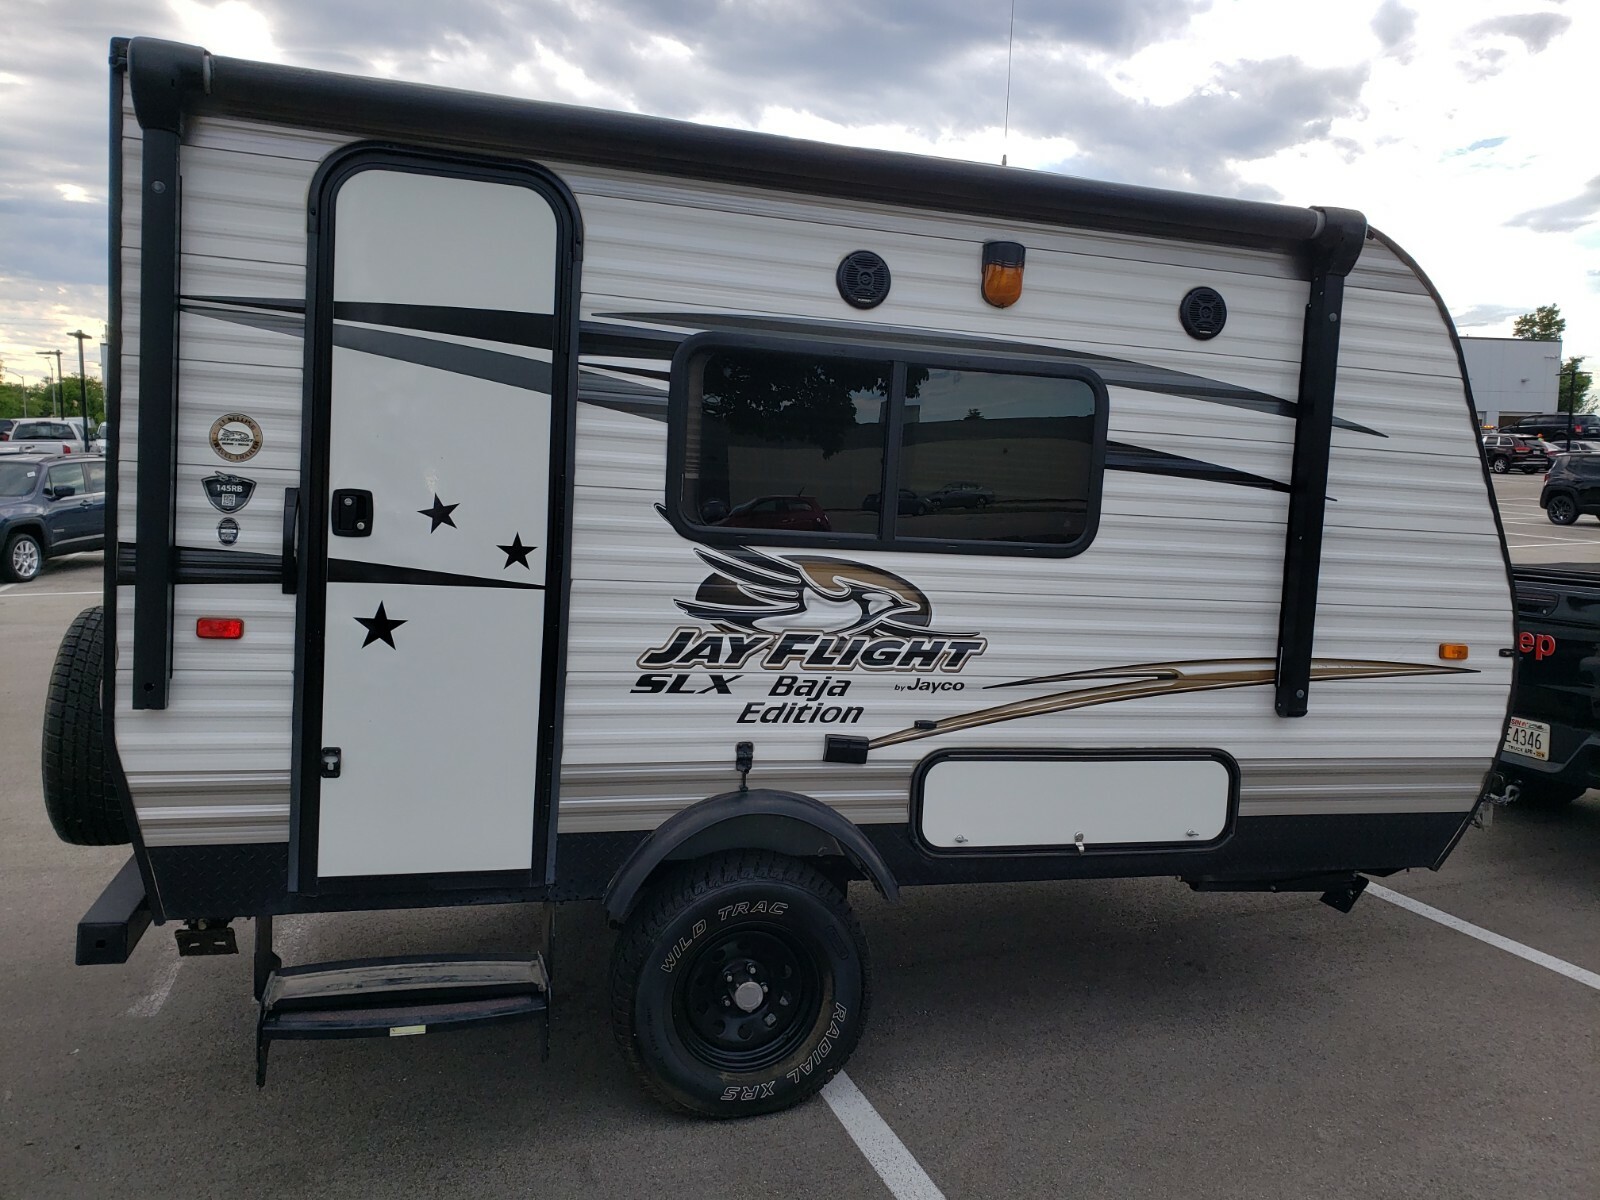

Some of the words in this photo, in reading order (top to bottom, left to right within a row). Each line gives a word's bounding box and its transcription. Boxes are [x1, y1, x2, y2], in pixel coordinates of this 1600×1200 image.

[216, 484, 243, 493] 145RB
[636, 626, 772, 669] JAY
[760, 629, 988, 673] FLIGHT
[1518, 631, 1556, 660] ep
[630, 674, 744, 694] SLX
[768, 675, 851, 701] Baja
[894, 683, 905, 692] by
[906, 678, 965, 691] Jayco
[736, 702, 864, 724] Edition
[660, 919, 707, 973] WILD
[717, 900, 788, 920] TRAC
[786, 1001, 847, 1084] RADIAL
[720, 1080, 776, 1101] XRS
